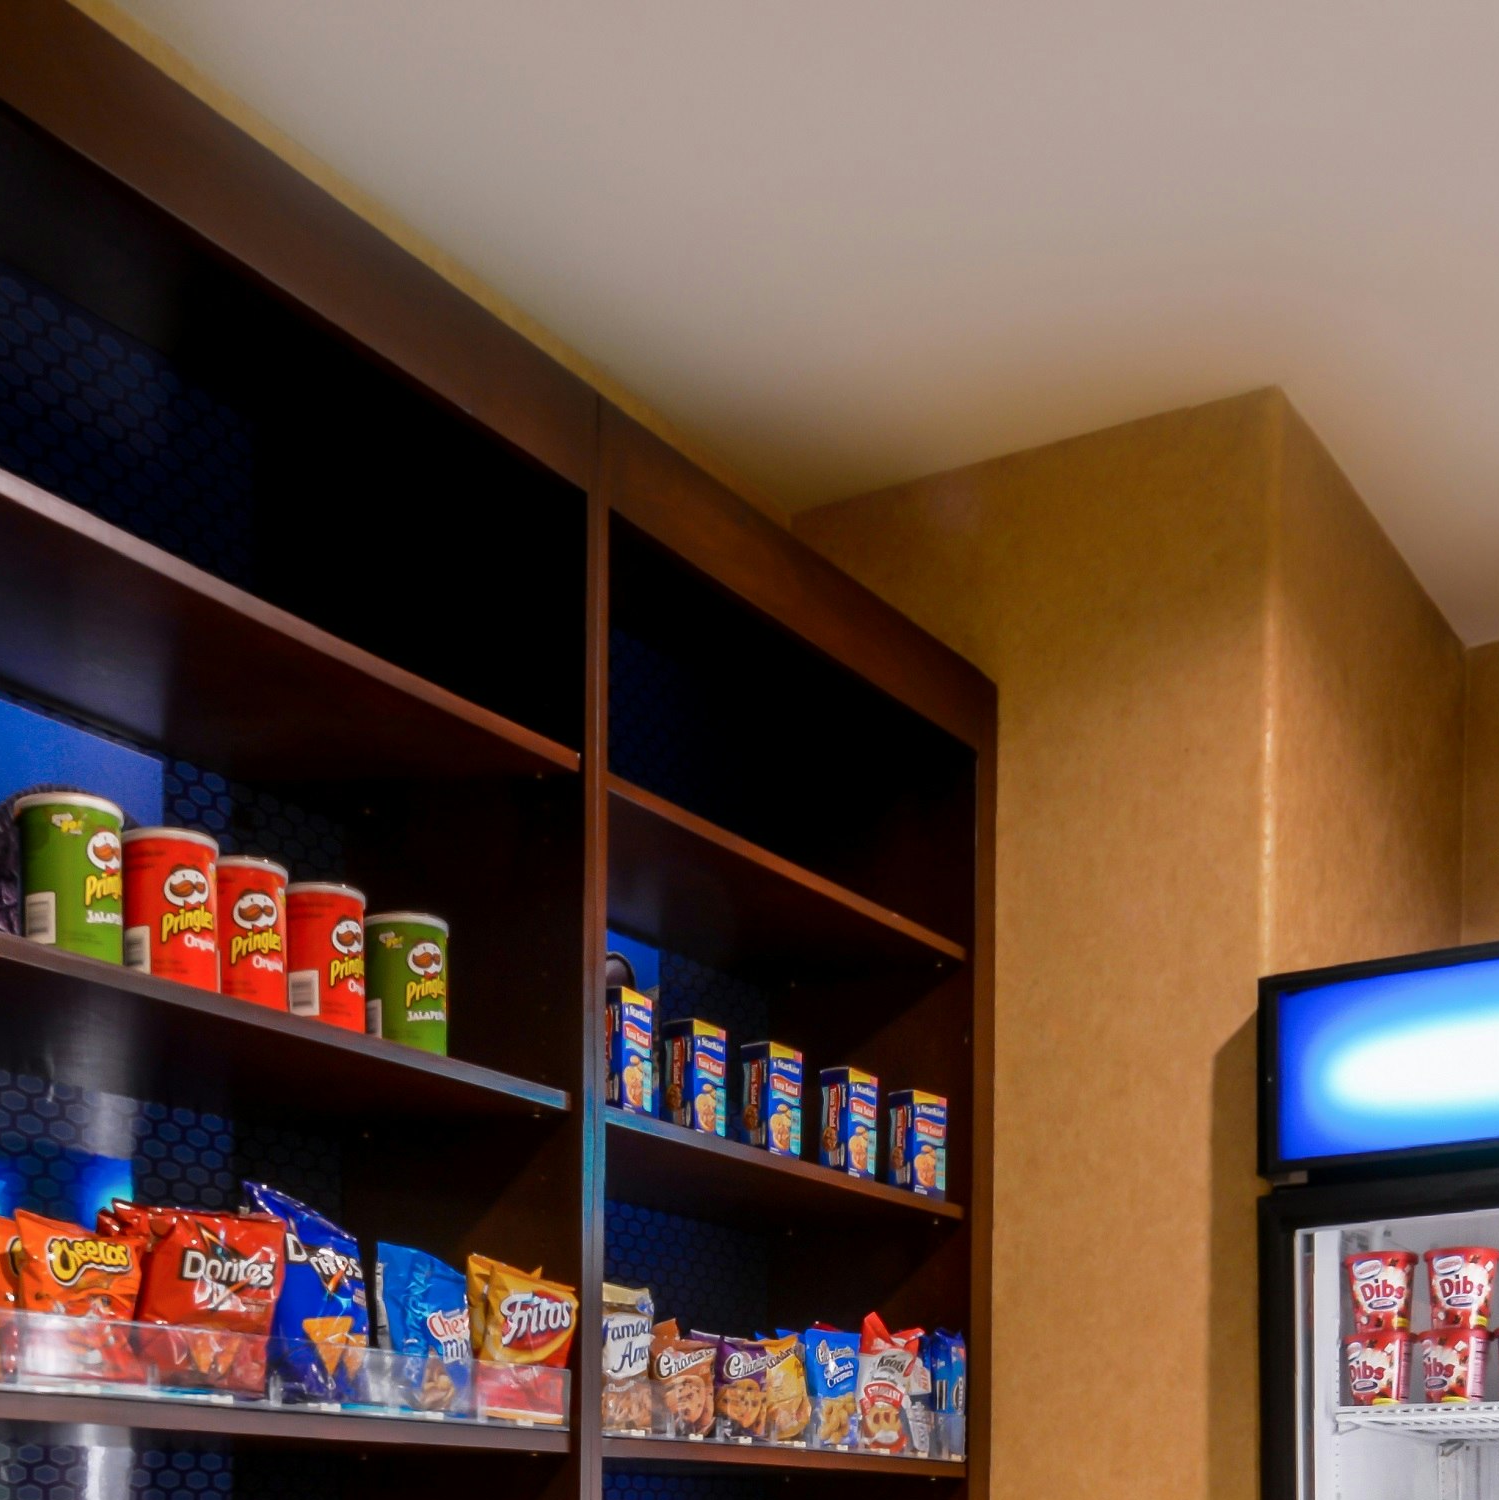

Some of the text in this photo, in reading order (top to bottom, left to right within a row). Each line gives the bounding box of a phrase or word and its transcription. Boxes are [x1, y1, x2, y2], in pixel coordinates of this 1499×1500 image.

[162, 905, 214, 943] Pringles
[231, 928, 282, 964] Pringles
[49, 1238, 130, 1283] Cheetos
[183, 1249, 275, 1287] Doritos
[1360, 1279, 1405, 1300] Dibs
[1439, 1275, 1484, 1298] Dibs
[502, 1292, 571, 1344] Fritos
